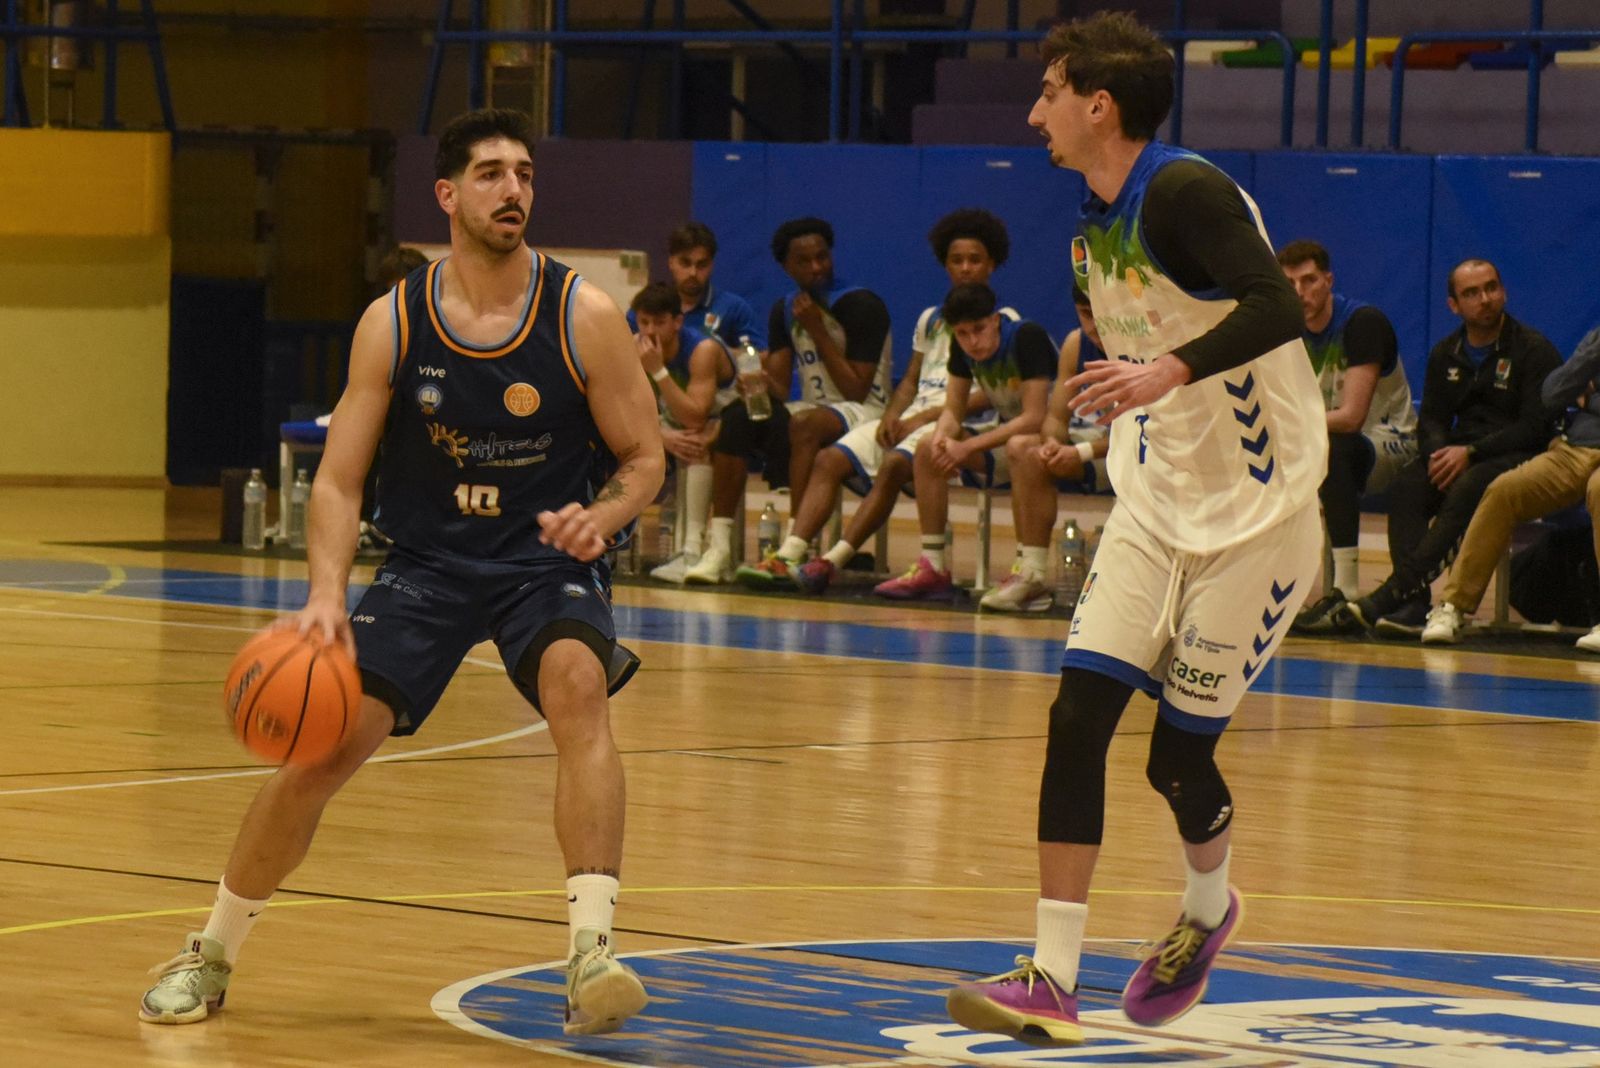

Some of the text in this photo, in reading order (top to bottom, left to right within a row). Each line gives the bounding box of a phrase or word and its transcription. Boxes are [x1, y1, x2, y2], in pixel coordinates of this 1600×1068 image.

[418, 365, 447, 378] vive
[453, 483, 502, 517] 10
[352, 614, 376, 624] vive
[1171, 656, 1227, 689] caser
[1177, 683, 1219, 702] Helvetia
